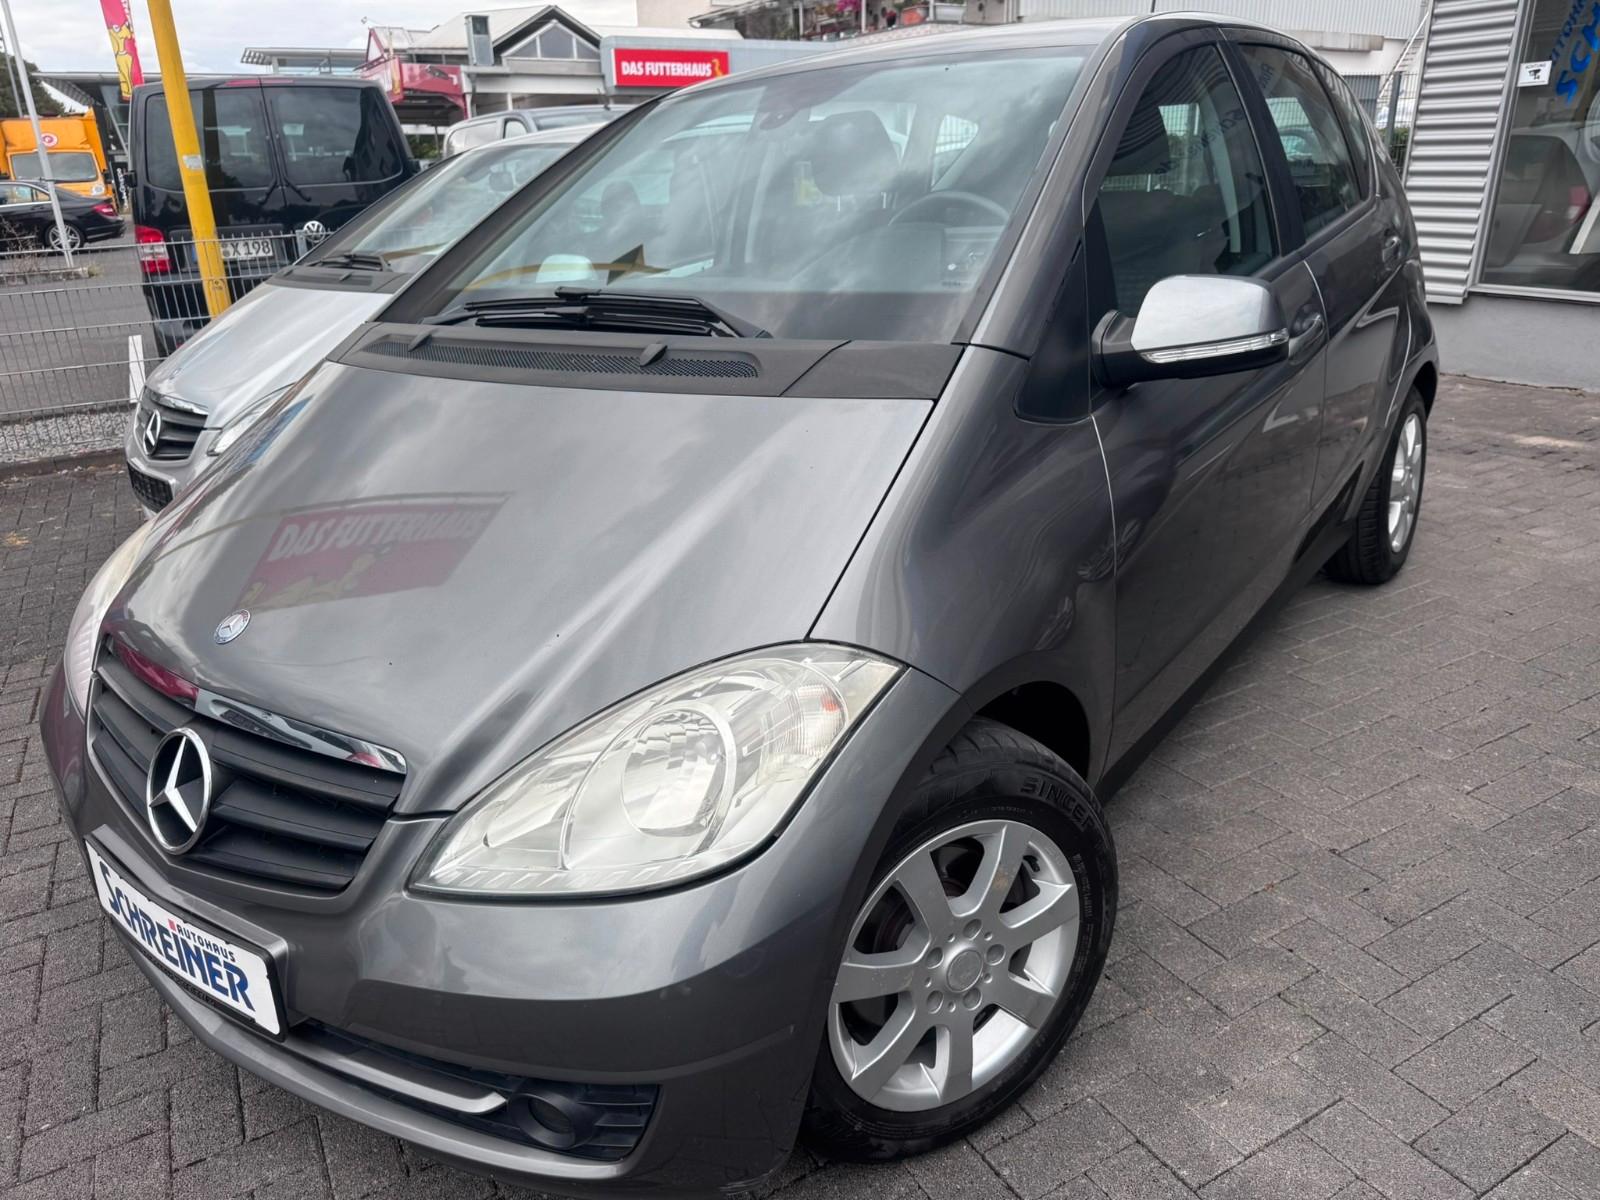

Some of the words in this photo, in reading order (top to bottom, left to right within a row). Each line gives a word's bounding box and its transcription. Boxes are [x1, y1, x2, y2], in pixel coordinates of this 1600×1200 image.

[621, 61, 644, 76] DAS
[645, 61, 712, 77] FUTTERHAUS
[230, 242, 241, 256] X
[244, 240, 271, 255] 198
[267, 517, 336, 562] DAS
[320, 511, 491, 551] FUTTERHAUS
[99, 860, 256, 1013] SCHREINER
[176, 924, 236, 963] AUTOHAUS
